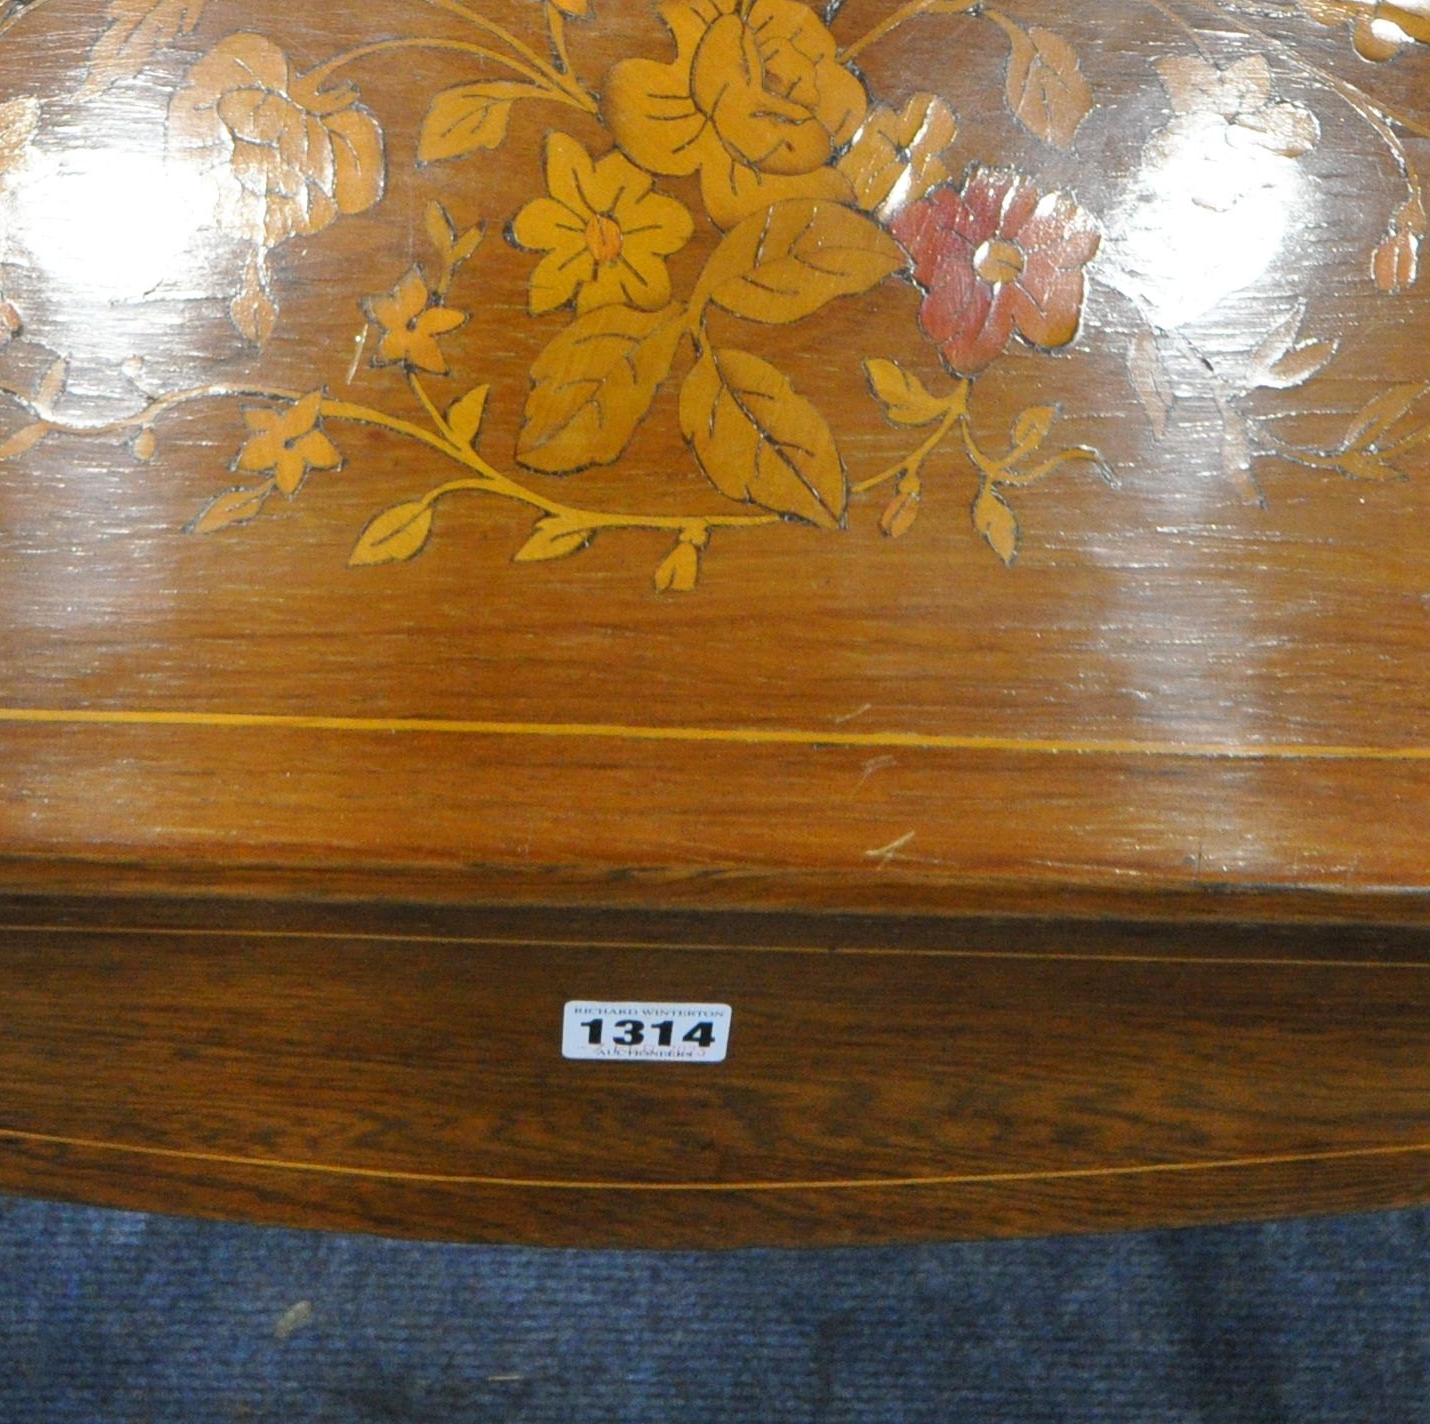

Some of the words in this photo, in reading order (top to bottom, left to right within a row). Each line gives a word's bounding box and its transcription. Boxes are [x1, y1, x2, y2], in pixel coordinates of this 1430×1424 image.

[574, 1007, 638, 1016] RICHARD
[642, 1008, 724, 1017] WINTERTON
[581, 1018, 716, 1048] 1314
